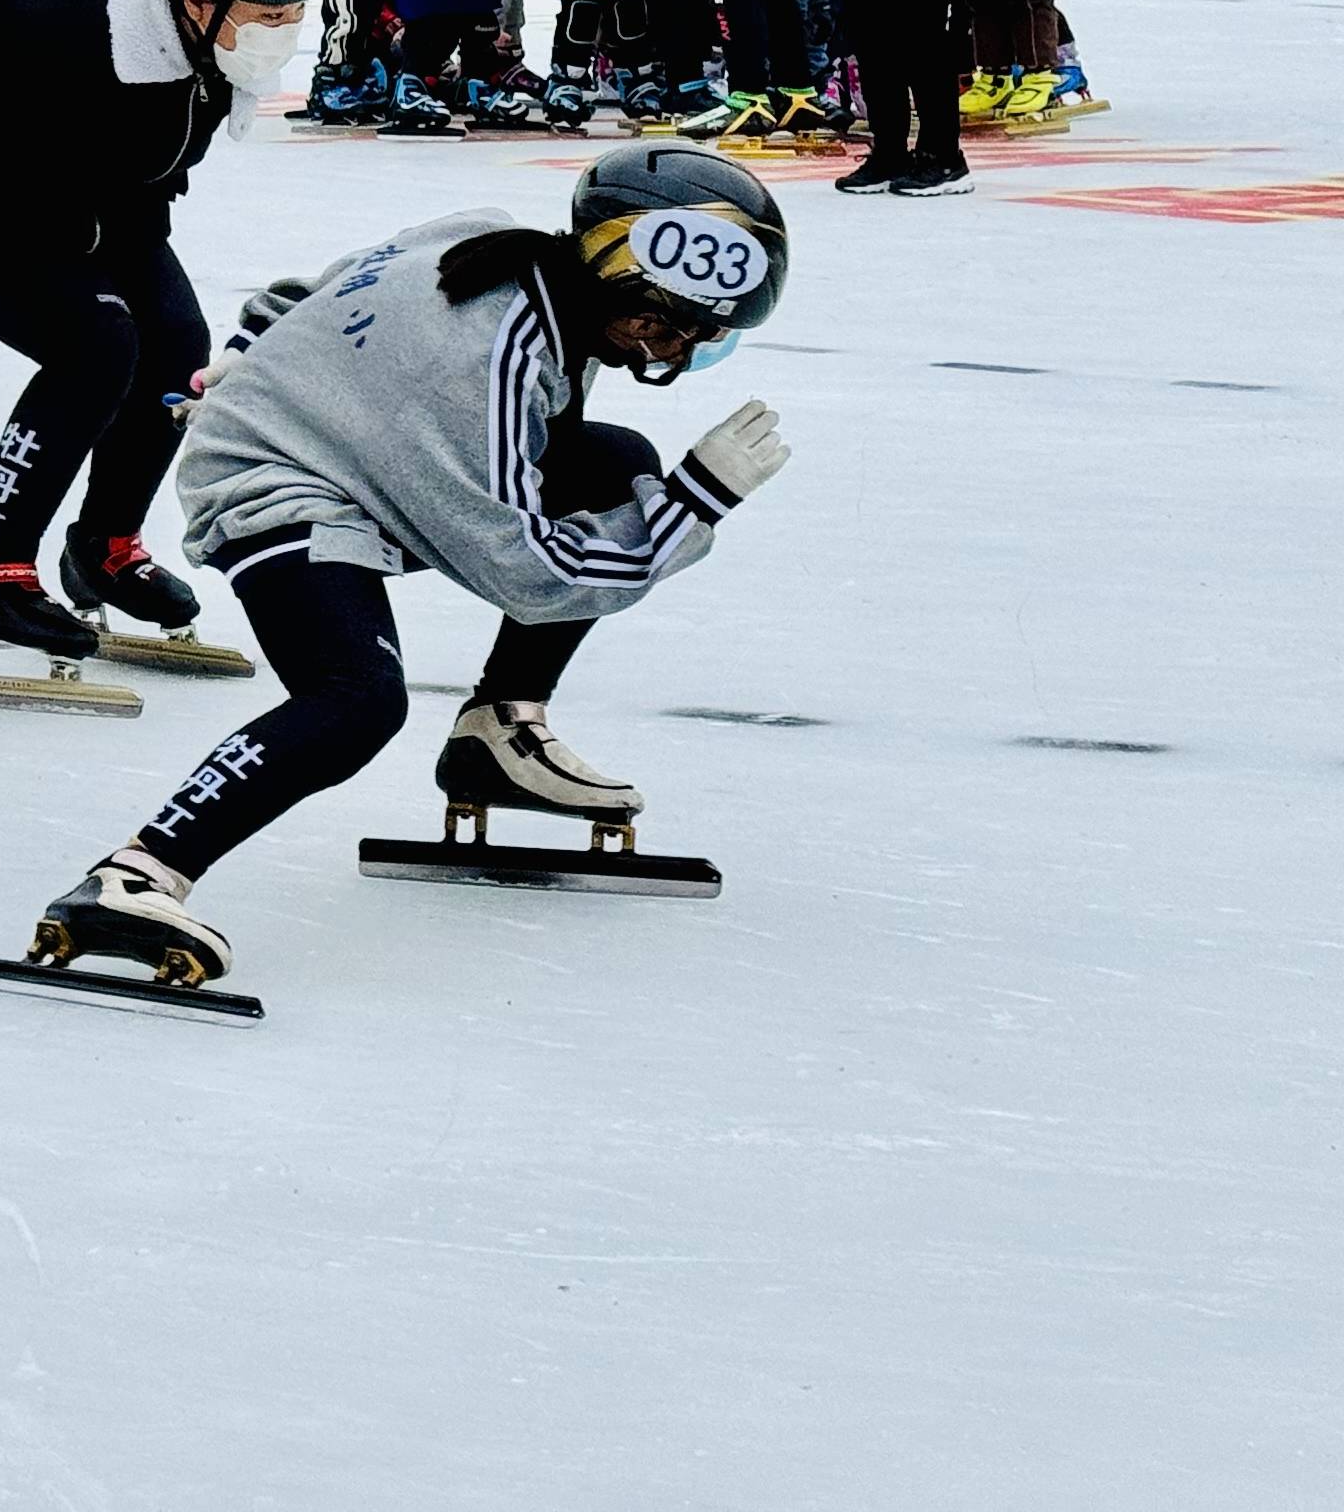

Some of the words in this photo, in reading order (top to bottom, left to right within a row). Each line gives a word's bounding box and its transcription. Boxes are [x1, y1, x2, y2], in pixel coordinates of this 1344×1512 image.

[648, 219, 752, 290] 033
[147, 733, 267, 838] 牡丹江
